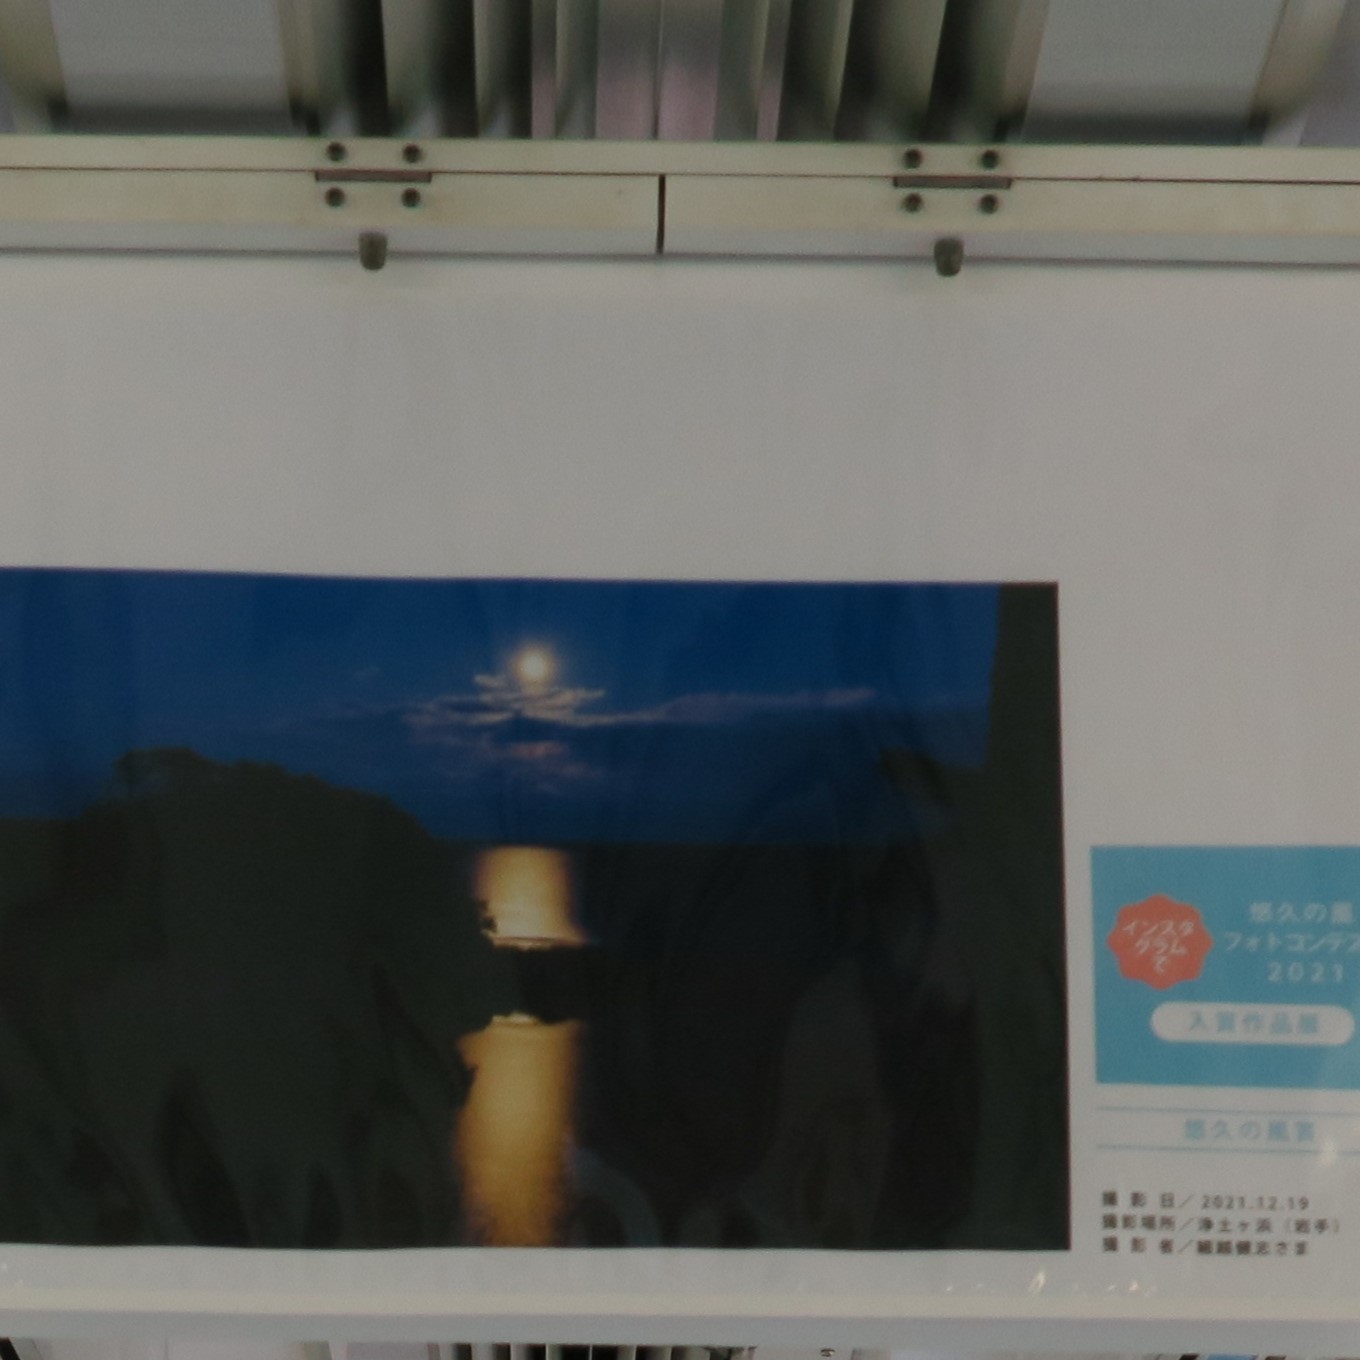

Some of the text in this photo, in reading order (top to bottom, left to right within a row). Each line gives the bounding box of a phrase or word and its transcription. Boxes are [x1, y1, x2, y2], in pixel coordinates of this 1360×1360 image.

[1122, 919, 1194, 936] インスタ
[1134, 938, 1187, 955] グラム
[1267, 962, 1344, 983] 2021
